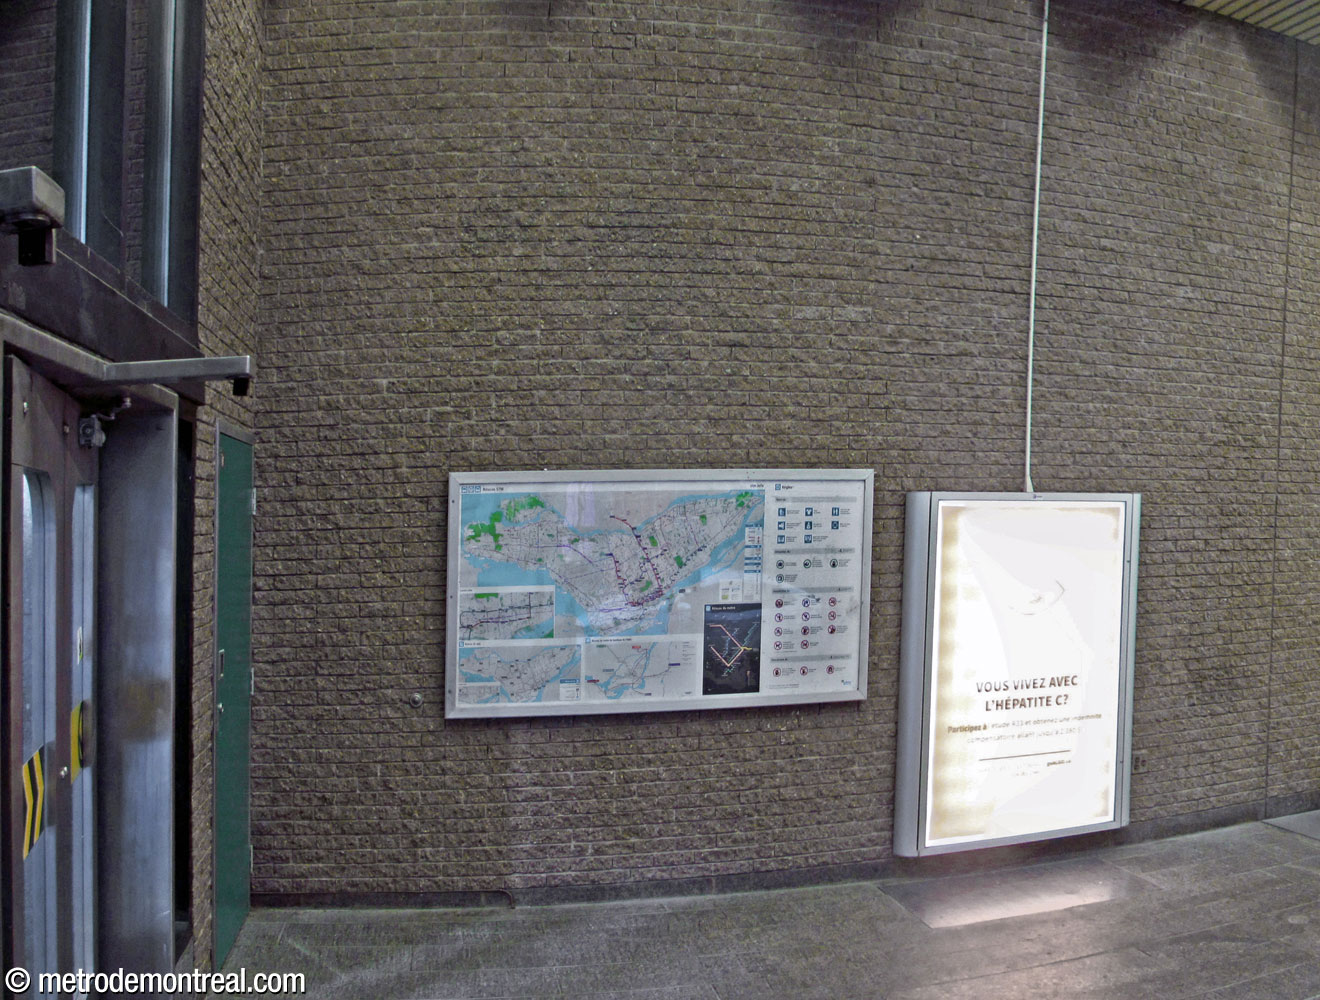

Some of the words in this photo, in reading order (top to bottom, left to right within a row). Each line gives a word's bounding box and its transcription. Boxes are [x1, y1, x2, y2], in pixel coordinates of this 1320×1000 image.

[976, 680, 1009, 693] VOUS
[1013, 678, 1046, 690] VIVEZ
[1049, 675, 1078, 688] AVEC
[1055, 694, 1069, 706] C?
[947, 725, 981, 734] Participez
[982, 723, 988, 731] à
